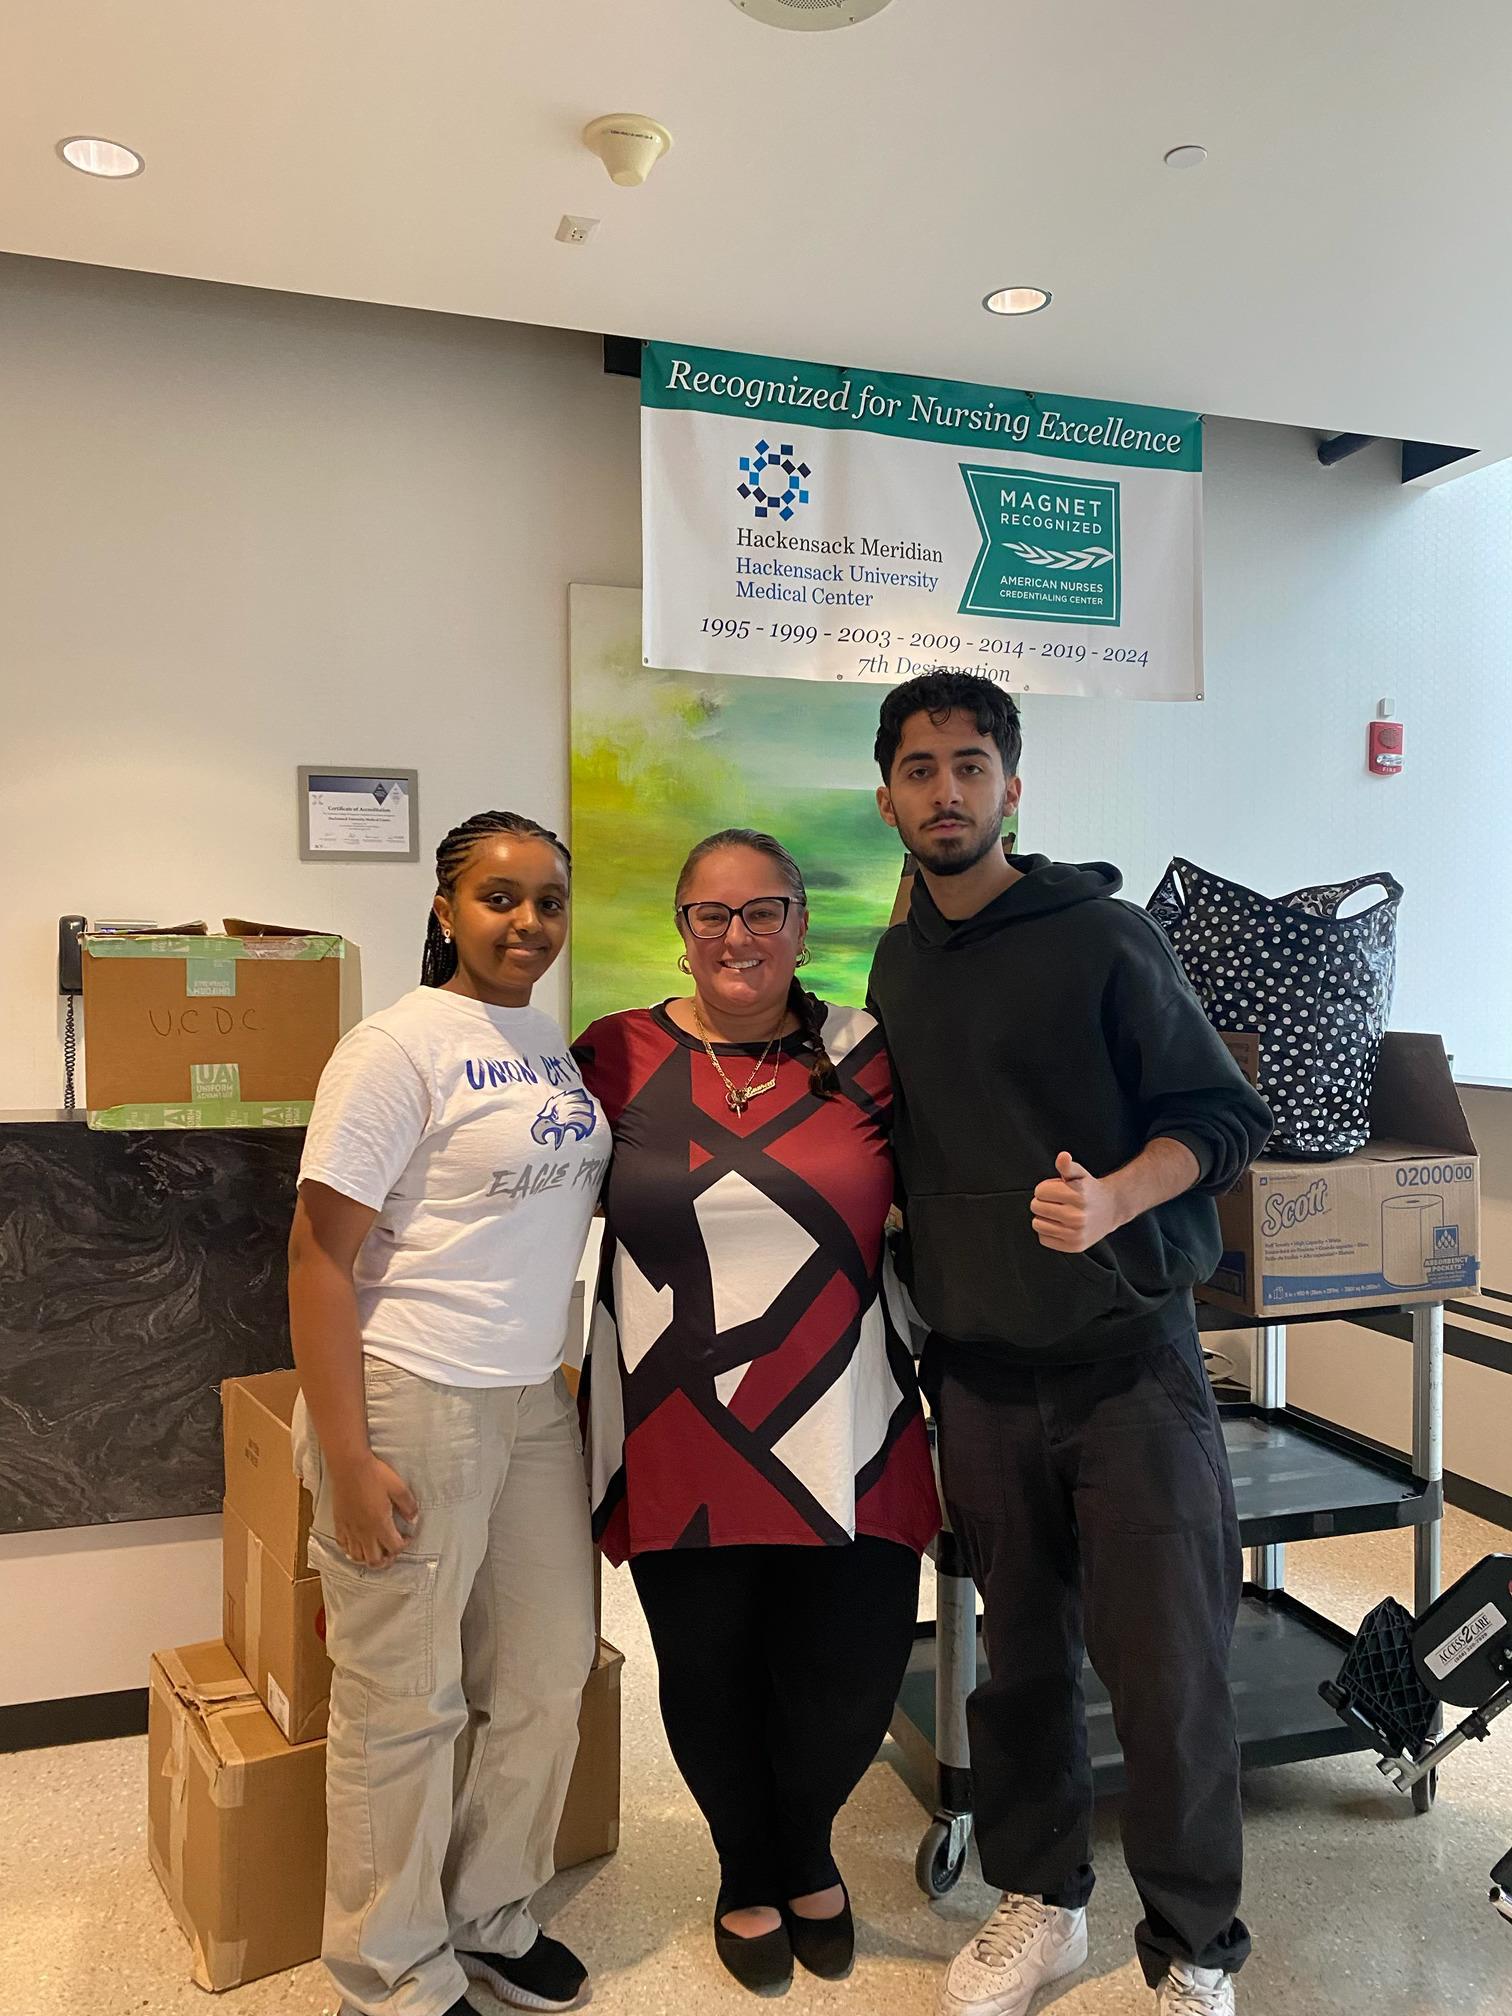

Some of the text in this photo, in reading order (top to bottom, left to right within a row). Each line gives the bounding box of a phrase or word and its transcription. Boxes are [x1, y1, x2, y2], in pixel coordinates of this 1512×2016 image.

[666, 360, 1182, 453] Recognized for Nursing Excellence
[1000, 490, 1102, 517] MAGNET
[1001, 514, 1102, 535] RECOGNIZED
[736, 528, 943, 564] Hackensack Meridian
[736, 557, 939, 592] Hackensack University
[1000, 575, 1103, 593] AMERICAN NURSES
[736, 580, 873, 607] Medical Center
[1000, 590, 1103, 605] CREDENTIALING CENTER
[699, 617, 751, 639] 1995
[769, 623, 818, 645] 1999
[837, 627, 891, 648] 2003
[909, 632, 961, 654] 2009
[979, 638, 1024, 659] 2014
[1041, 643, 1086, 662] 2019
[1103, 647, 1149, 667] 2024
[857, 655, 1011, 682] 7th Desination
[198, 1064, 234, 1083] UA
[486, 1162, 570, 1198] EAGLE
[1261, 1178, 1327, 1237] Scott
